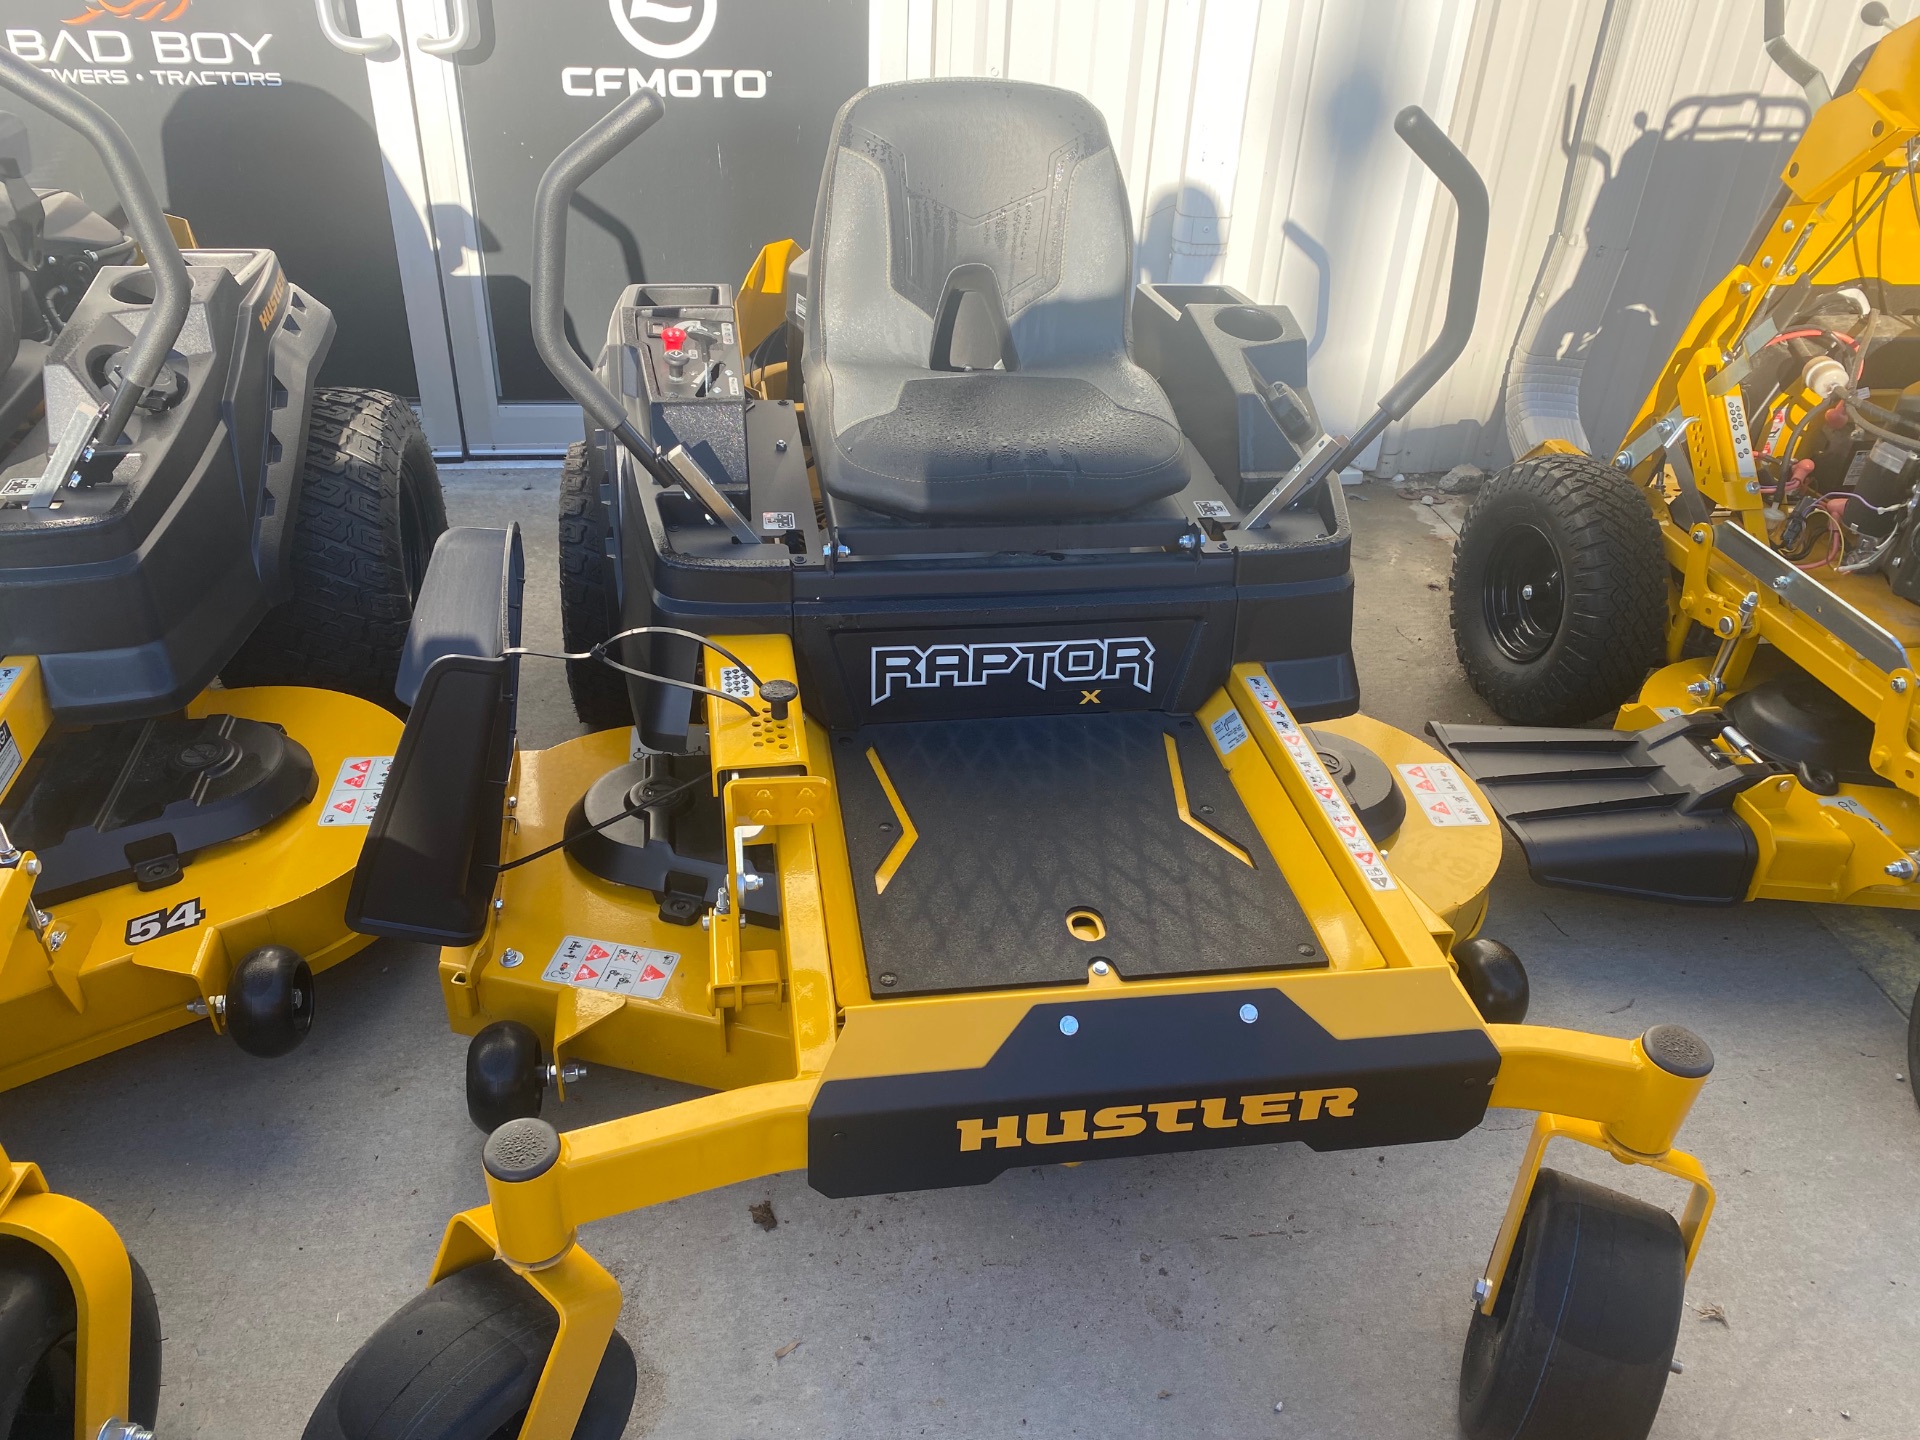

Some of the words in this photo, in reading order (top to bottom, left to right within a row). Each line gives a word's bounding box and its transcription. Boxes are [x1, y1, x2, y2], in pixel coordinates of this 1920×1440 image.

[5, 29, 132, 63] BAD
[150, 31, 272, 65] BOY
[40, 68, 129, 85] WERS
[149, 70, 282, 87] TRACTORS
[561, 67, 767, 98] CFMOTO
[870, 636, 1156, 706] RAPTOR
[1079, 690, 1102, 705] X
[127, 899, 203, 944] 54
[956, 1087, 1359, 1152] HUSTLER
